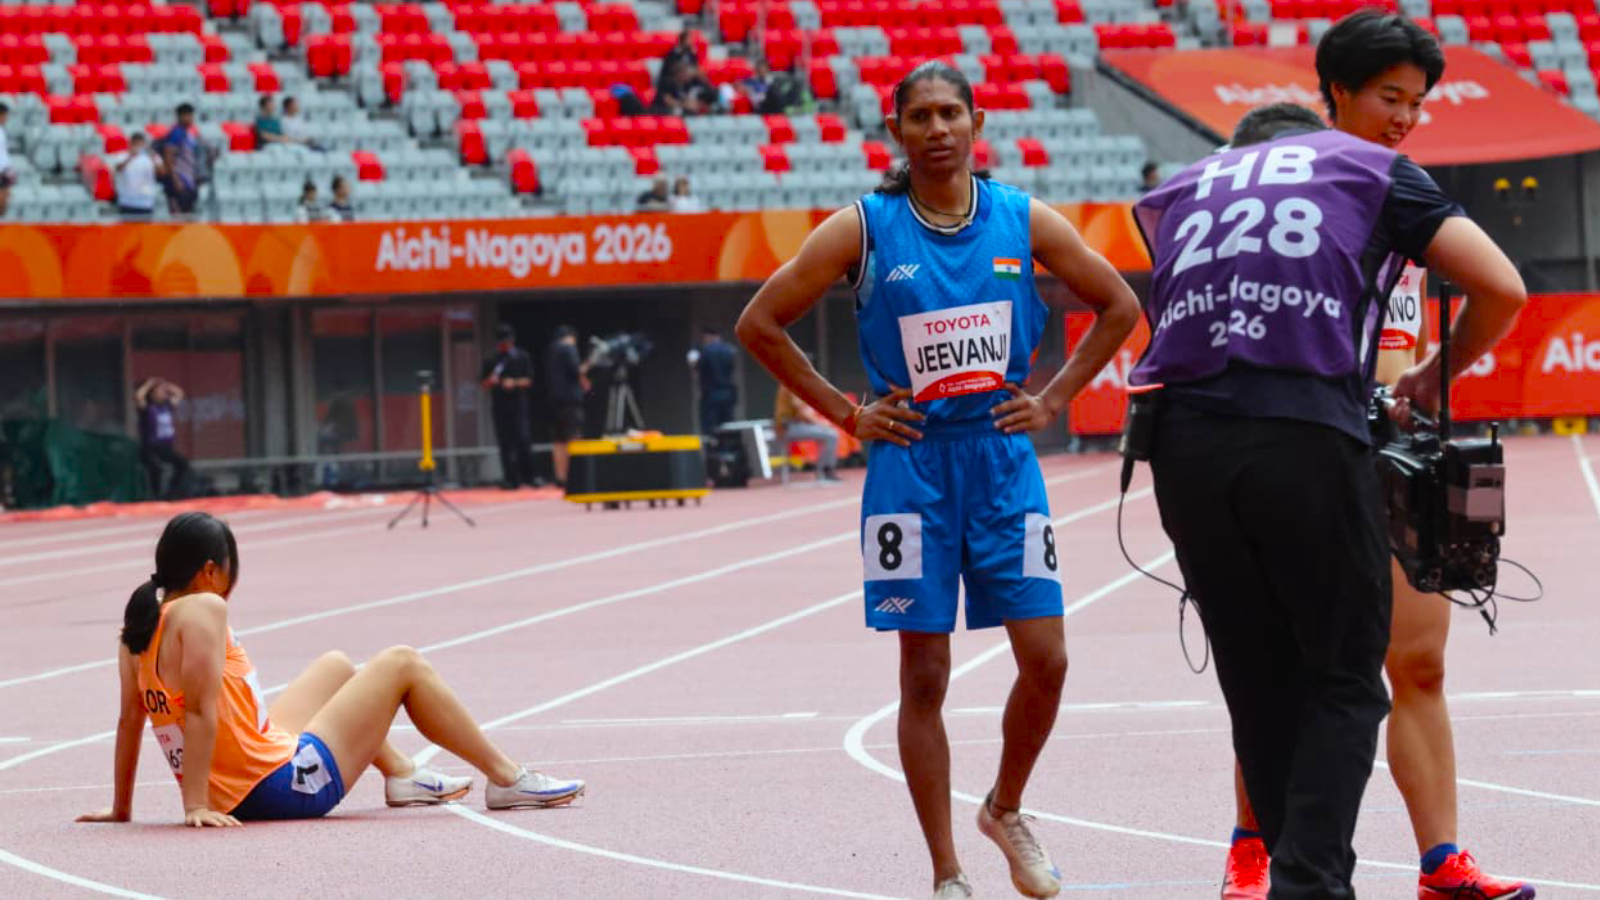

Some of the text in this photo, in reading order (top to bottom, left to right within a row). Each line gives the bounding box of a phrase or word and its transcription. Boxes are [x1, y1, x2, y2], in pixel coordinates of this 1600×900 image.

[1194, 145, 1318, 200] HB
[375, 222, 673, 278] Aichi-Nagoya 2026
[1172, 197, 1323, 277] 228
[923, 313, 991, 336] TOYOTA
[1209, 310, 1266, 347] 226
[914, 333, 1007, 375] JEEVANJI
[877, 522, 903, 571] 8
[1043, 524, 1058, 572] 8
[145, 688, 171, 715] OR
[296, 763, 319, 785] 7
